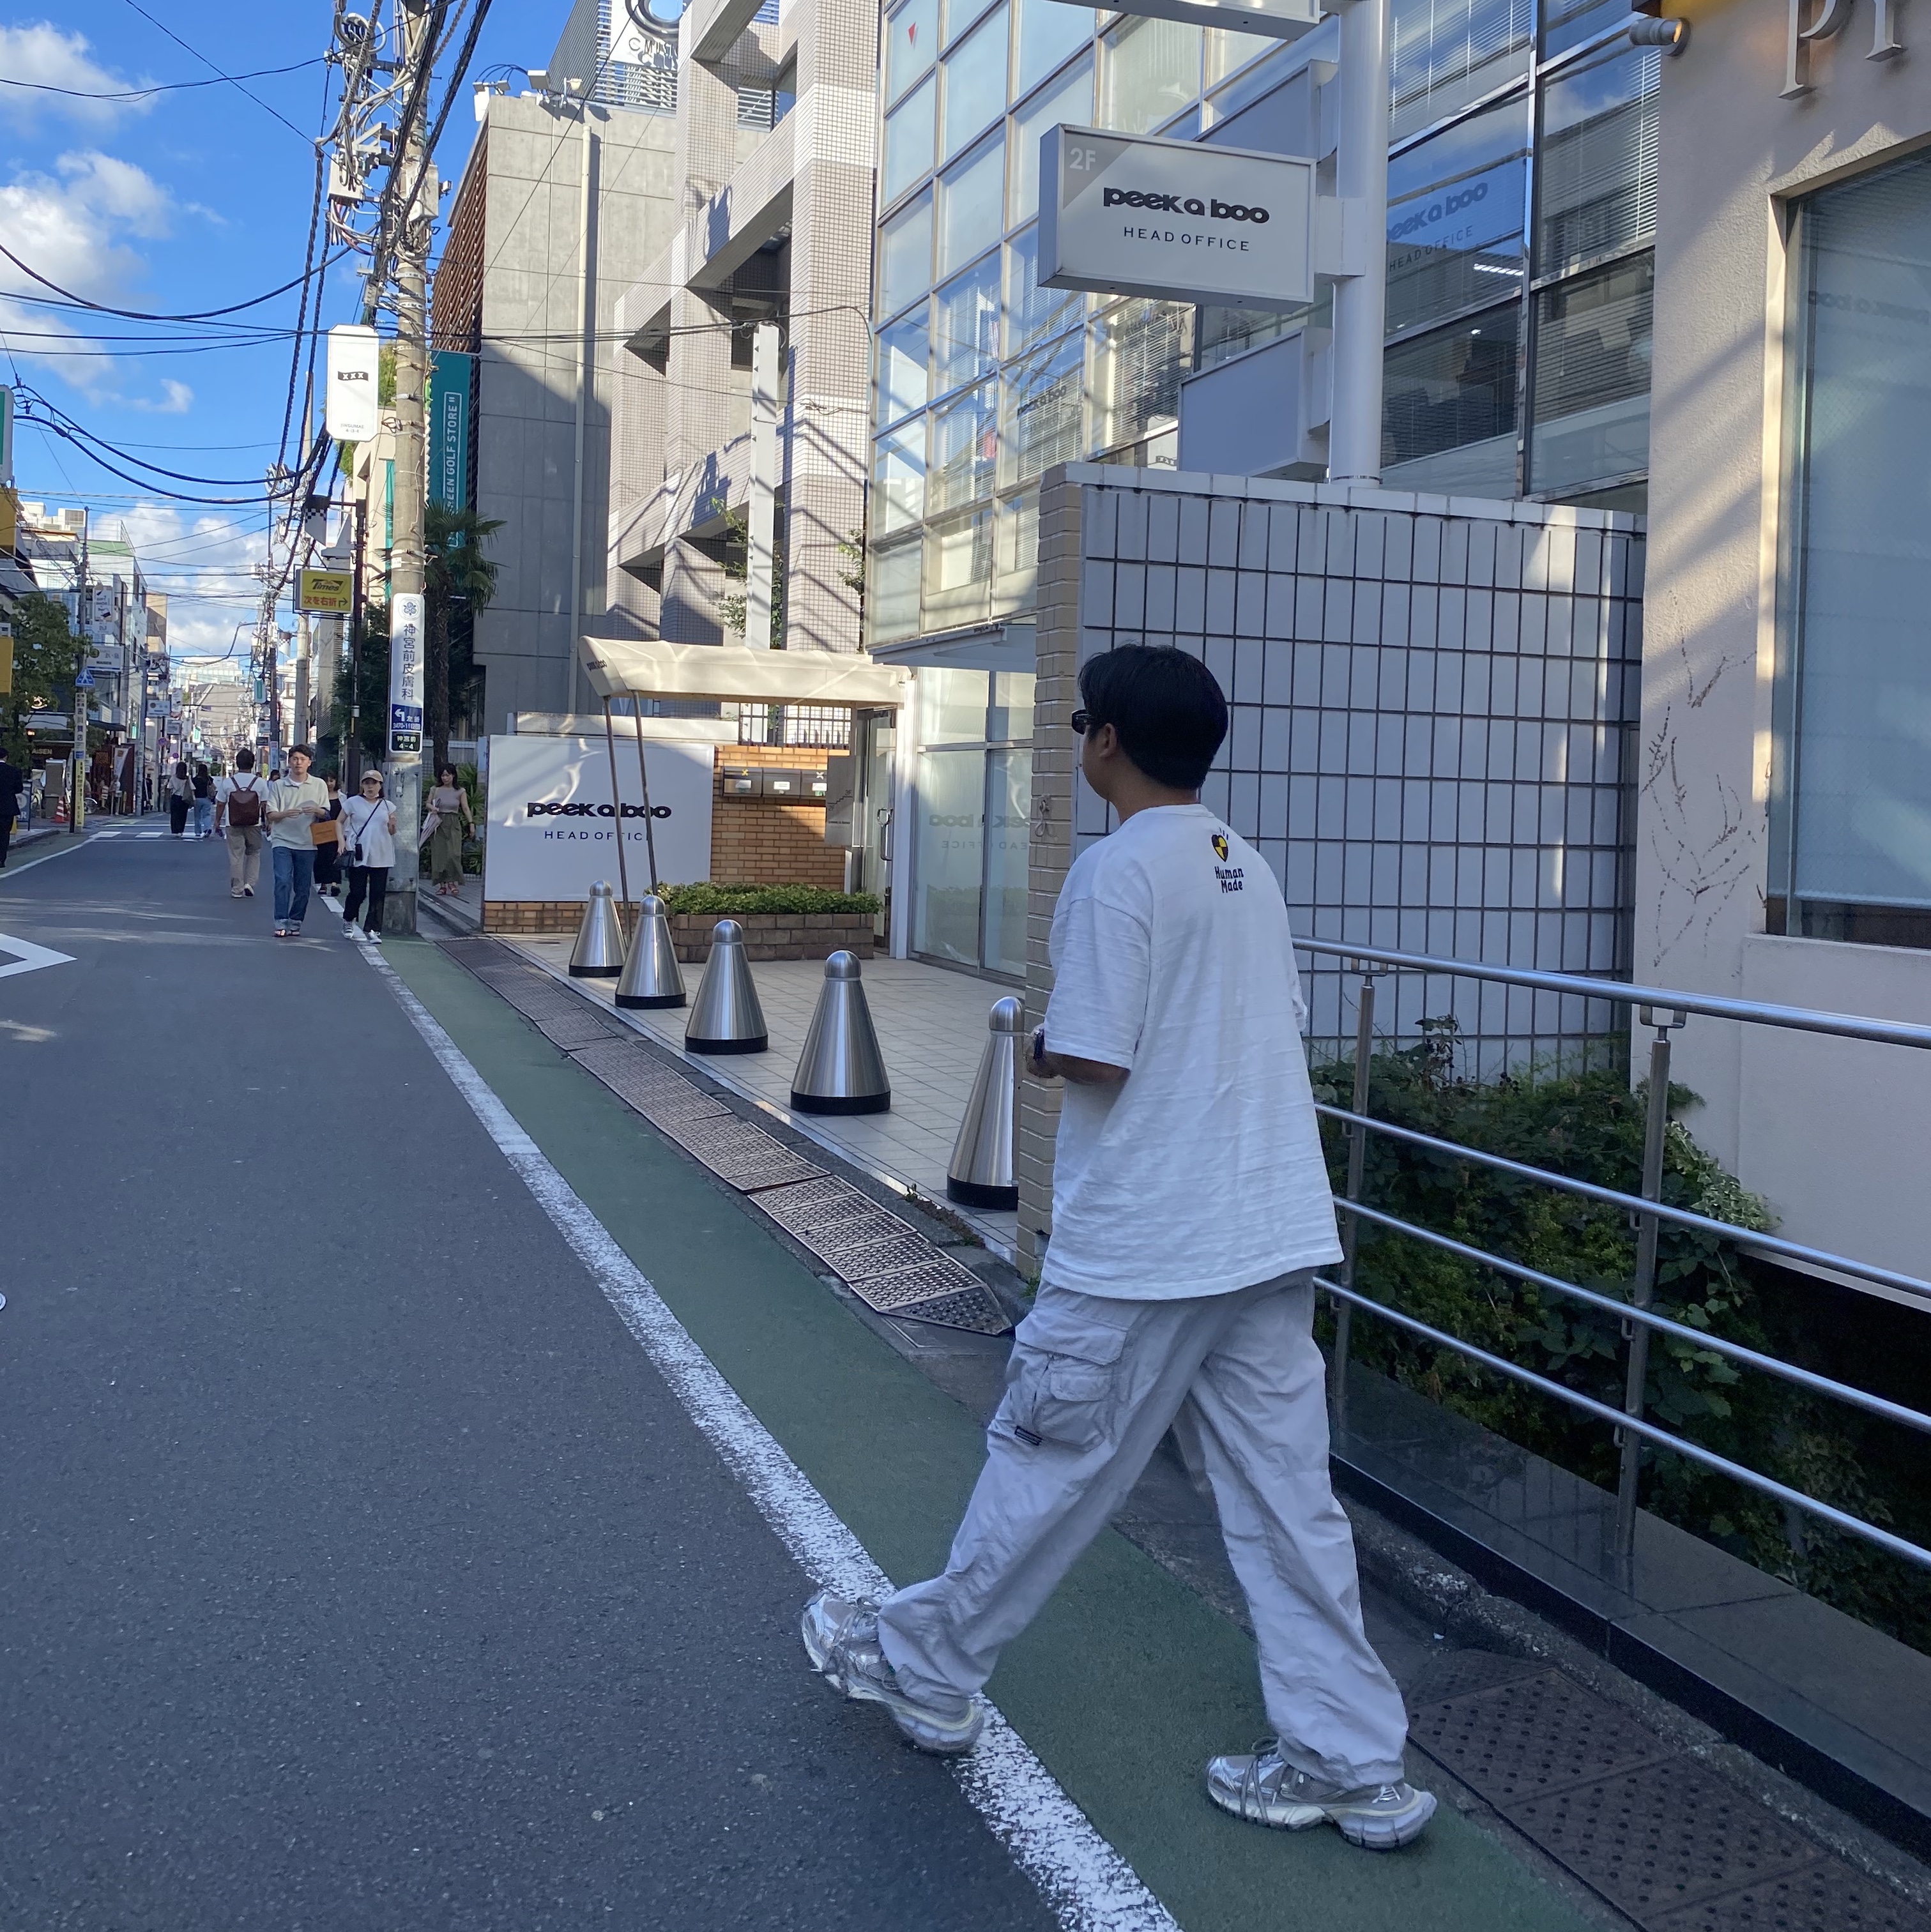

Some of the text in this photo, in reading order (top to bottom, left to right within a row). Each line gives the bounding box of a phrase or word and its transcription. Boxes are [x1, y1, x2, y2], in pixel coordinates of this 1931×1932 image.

[1069, 147, 1096, 171] 2F
[1124, 226, 1249, 252] HEAD OFFICE
[1389, 249, 1421, 272] HEAD
[447, 404, 457, 443] STORE
[446, 446, 456, 475] GOLF
[312, 579, 344, 591] Times
[304, 595, 337, 607] 次を右折
[401, 623, 416, 701] 神宮前皮膚科
[545, 831, 653, 841] HEAD OFIC
[1214, 866, 1244, 879] Human
[1221, 879, 1243, 894] Made
